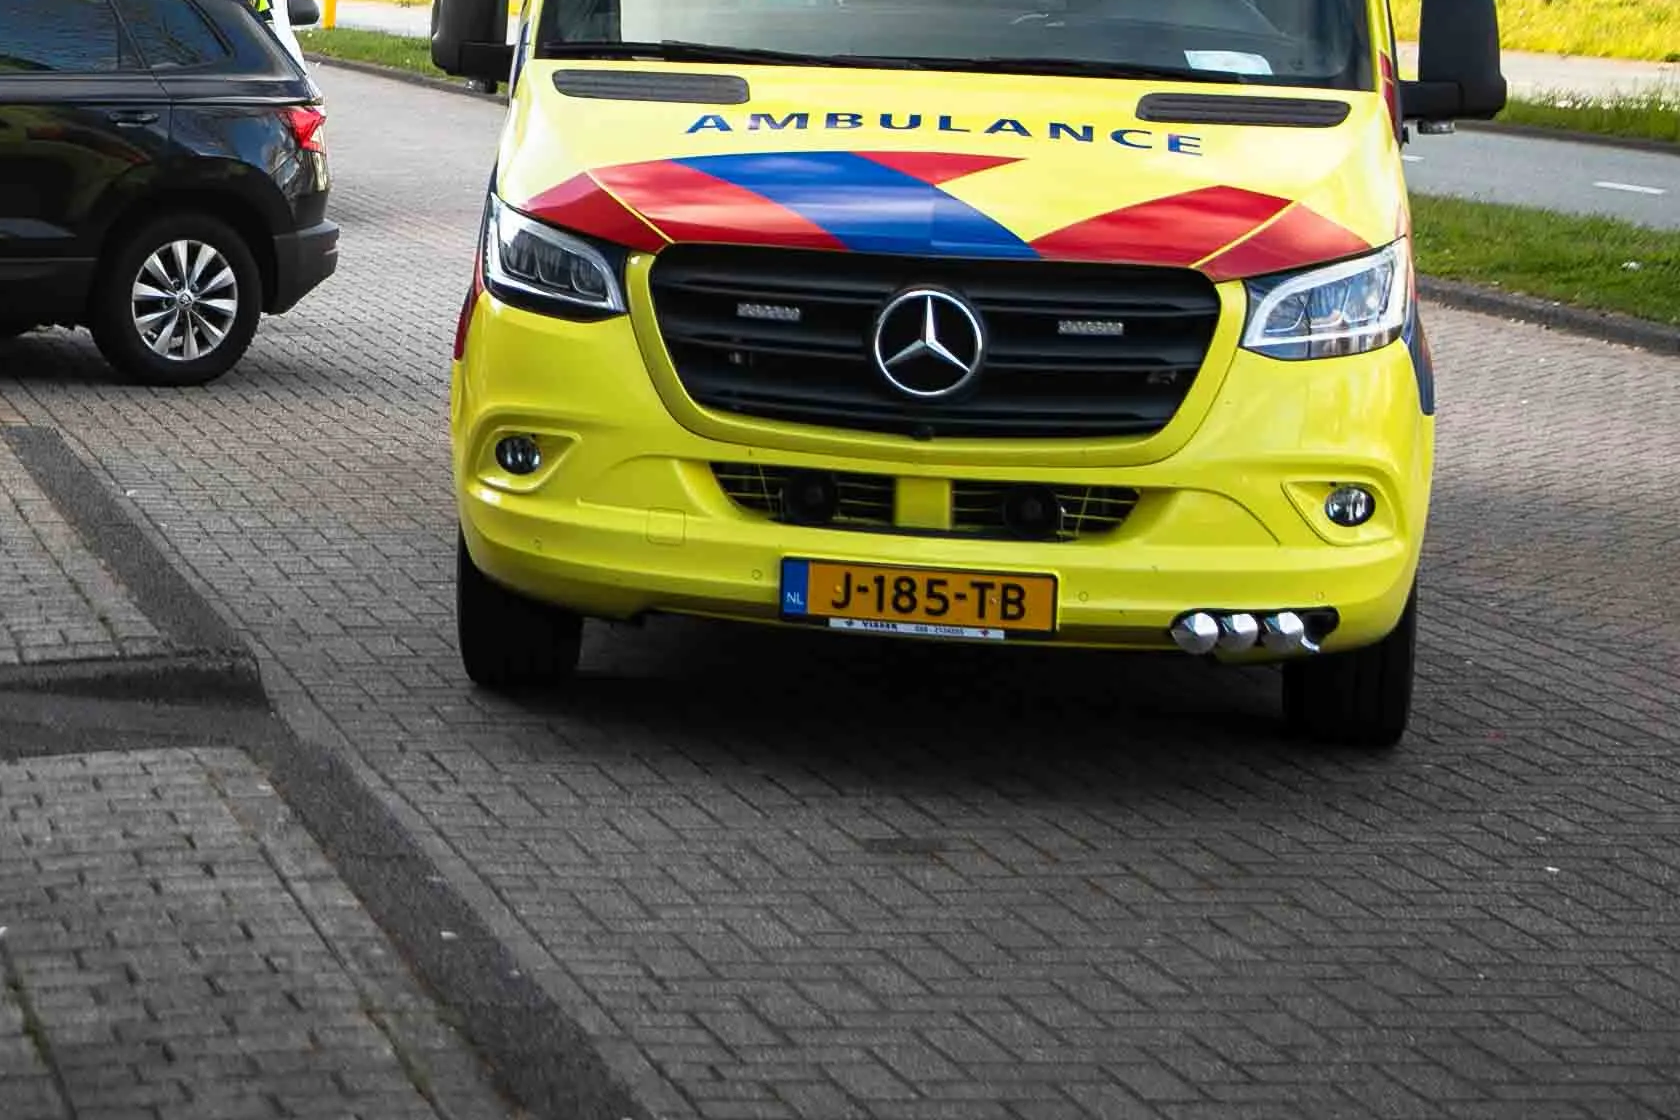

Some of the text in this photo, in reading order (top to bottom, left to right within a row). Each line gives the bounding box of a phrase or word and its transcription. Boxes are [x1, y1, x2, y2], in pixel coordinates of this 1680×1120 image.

[686, 112, 1203, 156] AMBULANCE
[786, 571, 1027, 621] NL J-185-TB
